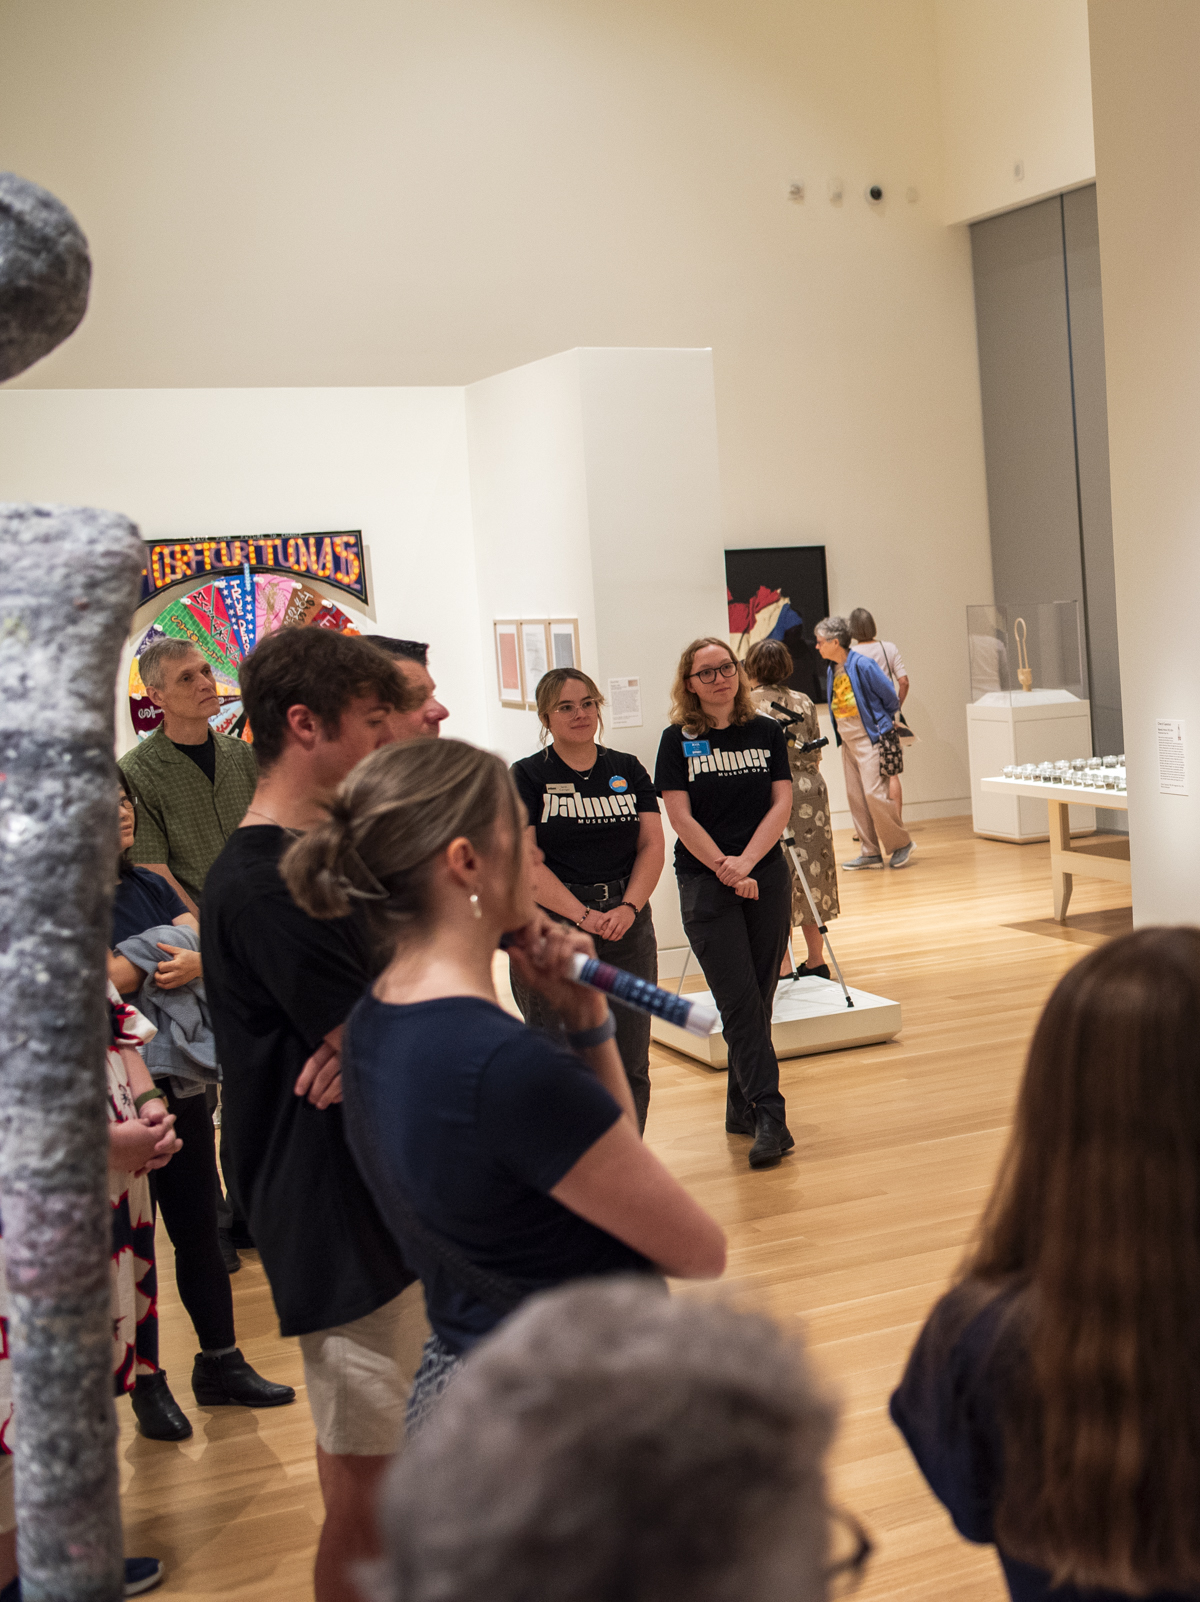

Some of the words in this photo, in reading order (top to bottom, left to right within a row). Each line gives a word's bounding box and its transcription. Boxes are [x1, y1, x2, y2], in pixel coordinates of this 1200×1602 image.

[230, 579, 244, 616] TRUE
[688, 748, 771, 782] palmer
[717, 769, 749, 777] MUSEUM
[541, 792, 637, 823] palmer
